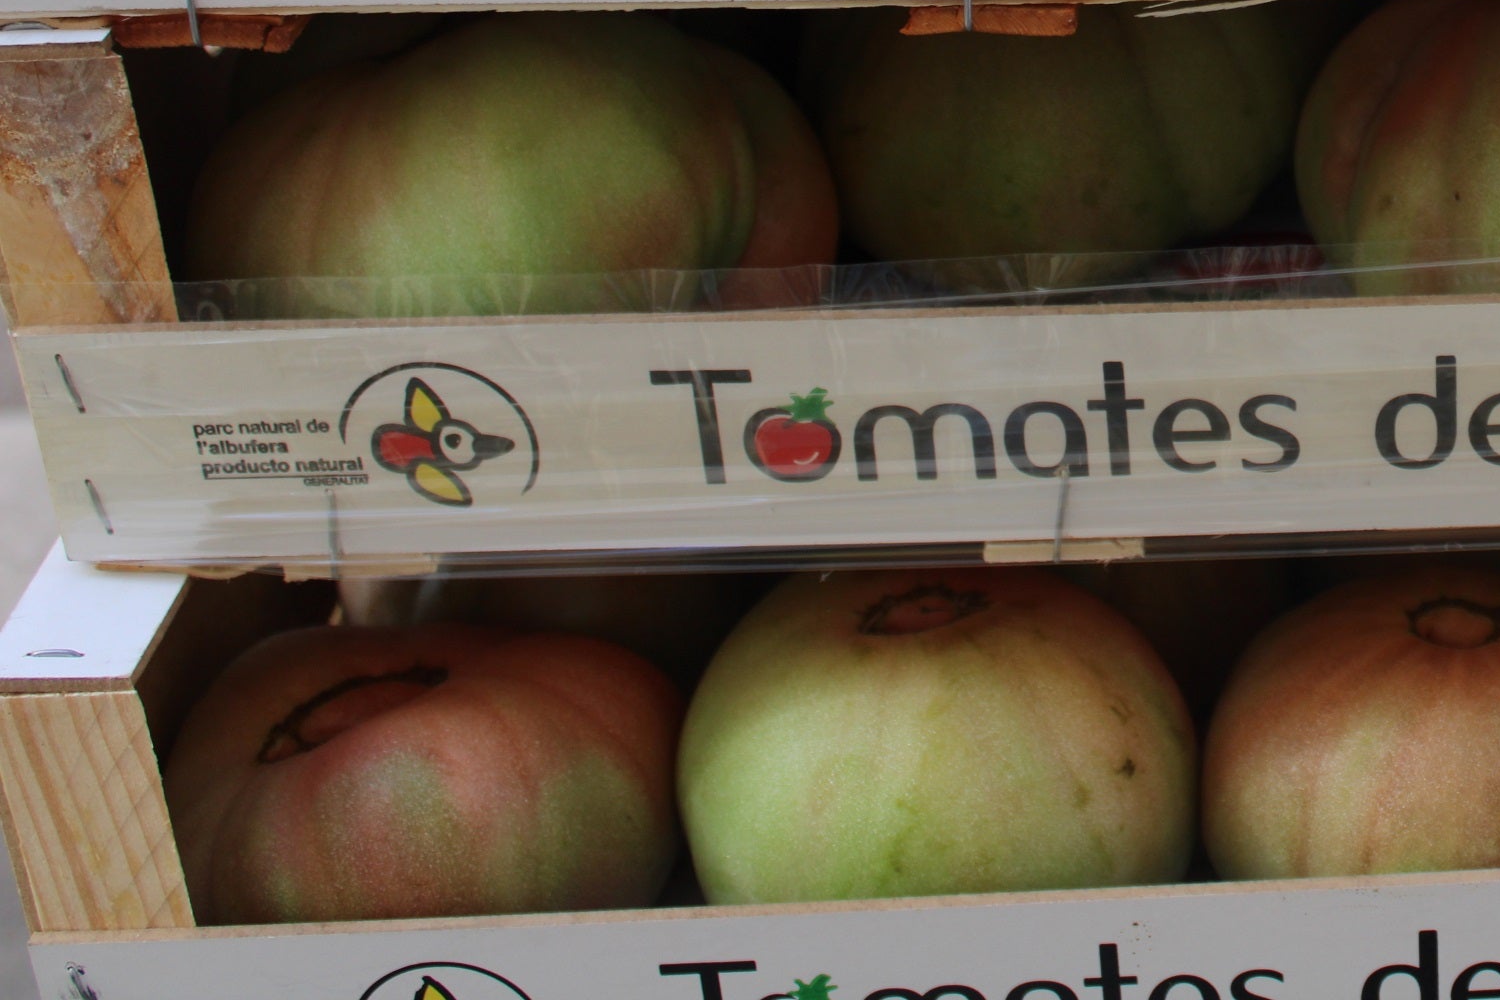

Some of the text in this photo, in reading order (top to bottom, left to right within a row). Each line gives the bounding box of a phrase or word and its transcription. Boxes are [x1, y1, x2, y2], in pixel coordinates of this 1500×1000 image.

[193, 418, 330, 439] parc natural de
[649, 361, 1300, 485] Tomates
[197, 440, 289, 455] l'albufera
[202, 456, 364, 477] producto natural
